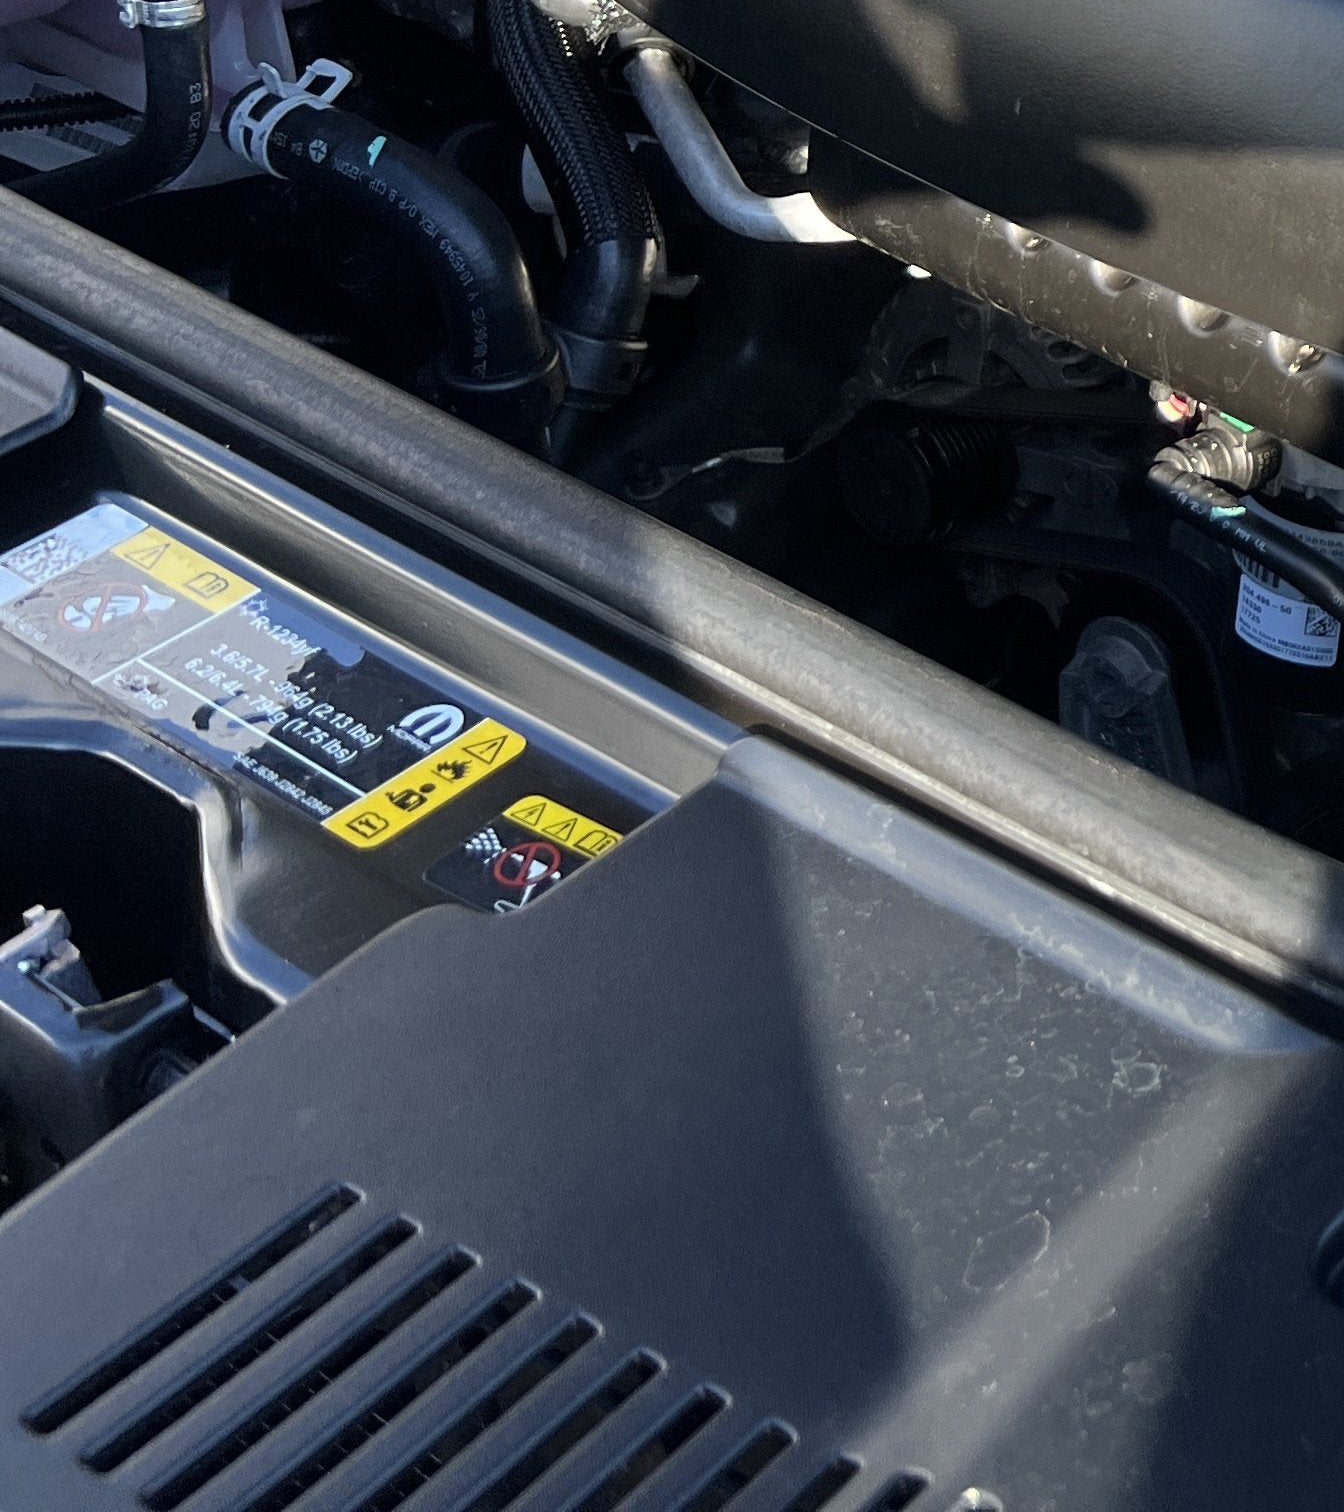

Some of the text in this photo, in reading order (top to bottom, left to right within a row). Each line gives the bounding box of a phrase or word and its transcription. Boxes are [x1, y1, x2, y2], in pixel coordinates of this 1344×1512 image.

[281, 717, 331, 745] (1.75
[321, 737, 359, 765] lbs)
[308, 702, 354, 729] (2.13
[348, 721, 384, 749] lbs)
